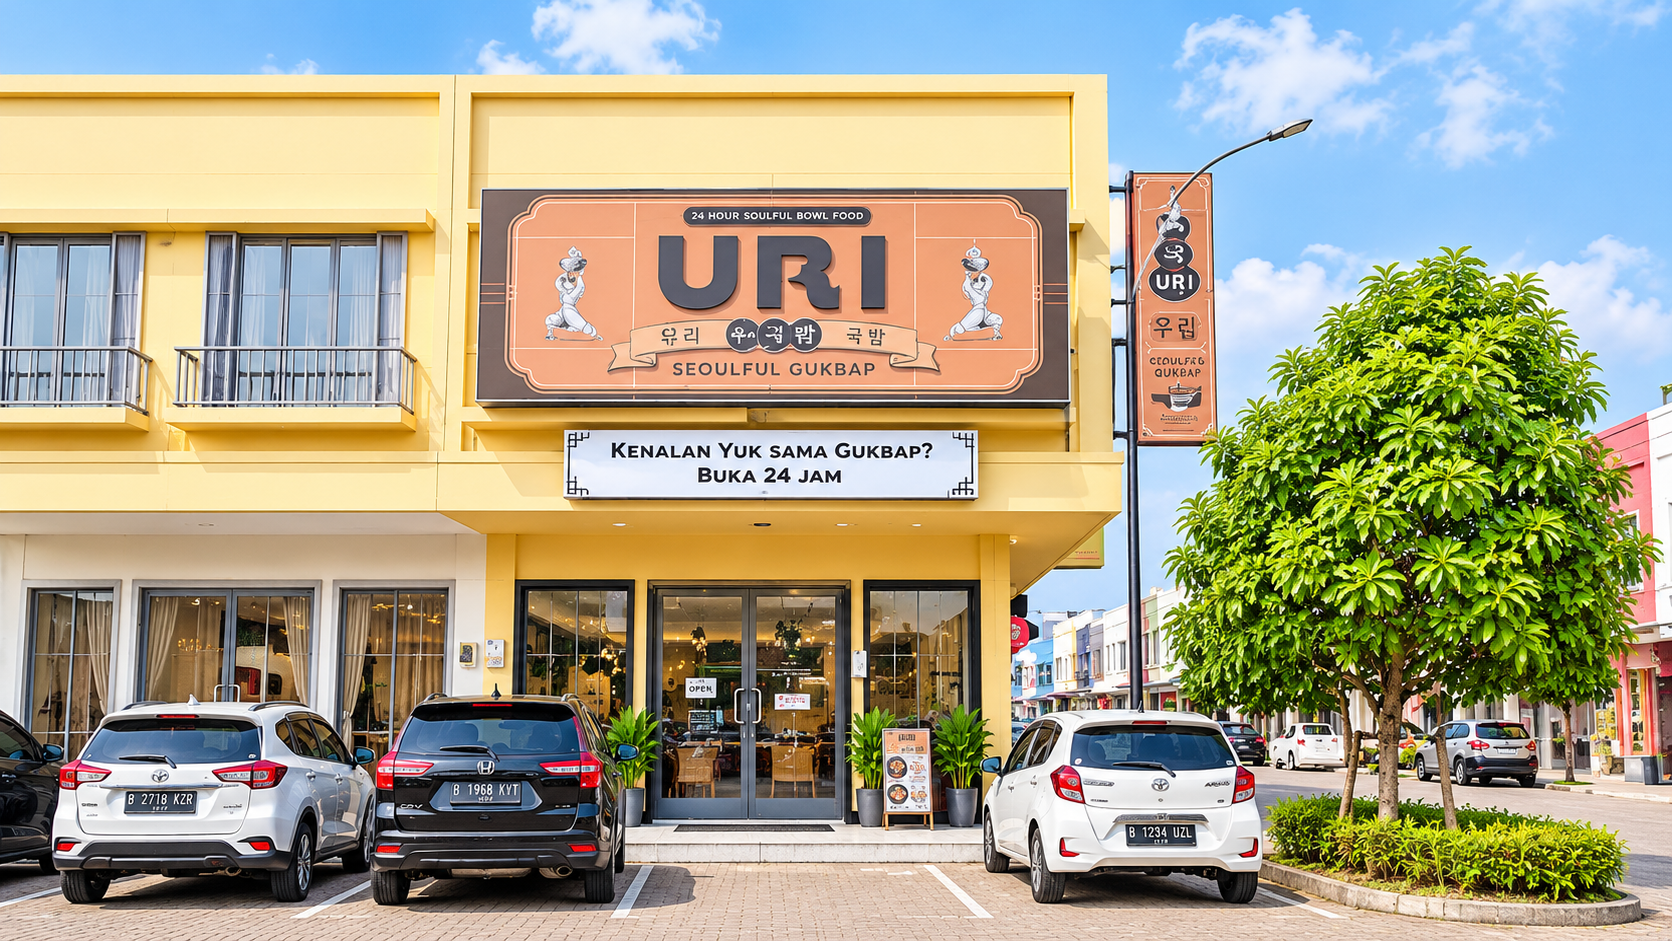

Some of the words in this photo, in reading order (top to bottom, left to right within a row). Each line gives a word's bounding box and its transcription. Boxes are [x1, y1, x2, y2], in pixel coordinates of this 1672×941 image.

[691, 211, 704, 220] 24
[708, 211, 740, 220] HOUR
[743, 211, 792, 220] SOULFUL
[796, 211, 829, 220] BOWL
[832, 211, 864, 220] FOOD
[658, 235, 886, 311] URI
[1155, 273, 1193, 290] URI
[672, 362, 780, 376] SEOULFUL
[789, 362, 875, 376] GUKBAP
[763, 467, 792, 483] 24
[452, 783, 460, 796] B
[467, 783, 493, 796] 1968
[498, 783, 519, 796] KYT
[127, 793, 135, 805] B
[141, 793, 168, 805] 2718
[173, 793, 194, 805] KZR
[1128, 826, 1136, 838] B
[1142, 826, 1167, 838] 1234
[1172, 826, 1193, 838] UZL
